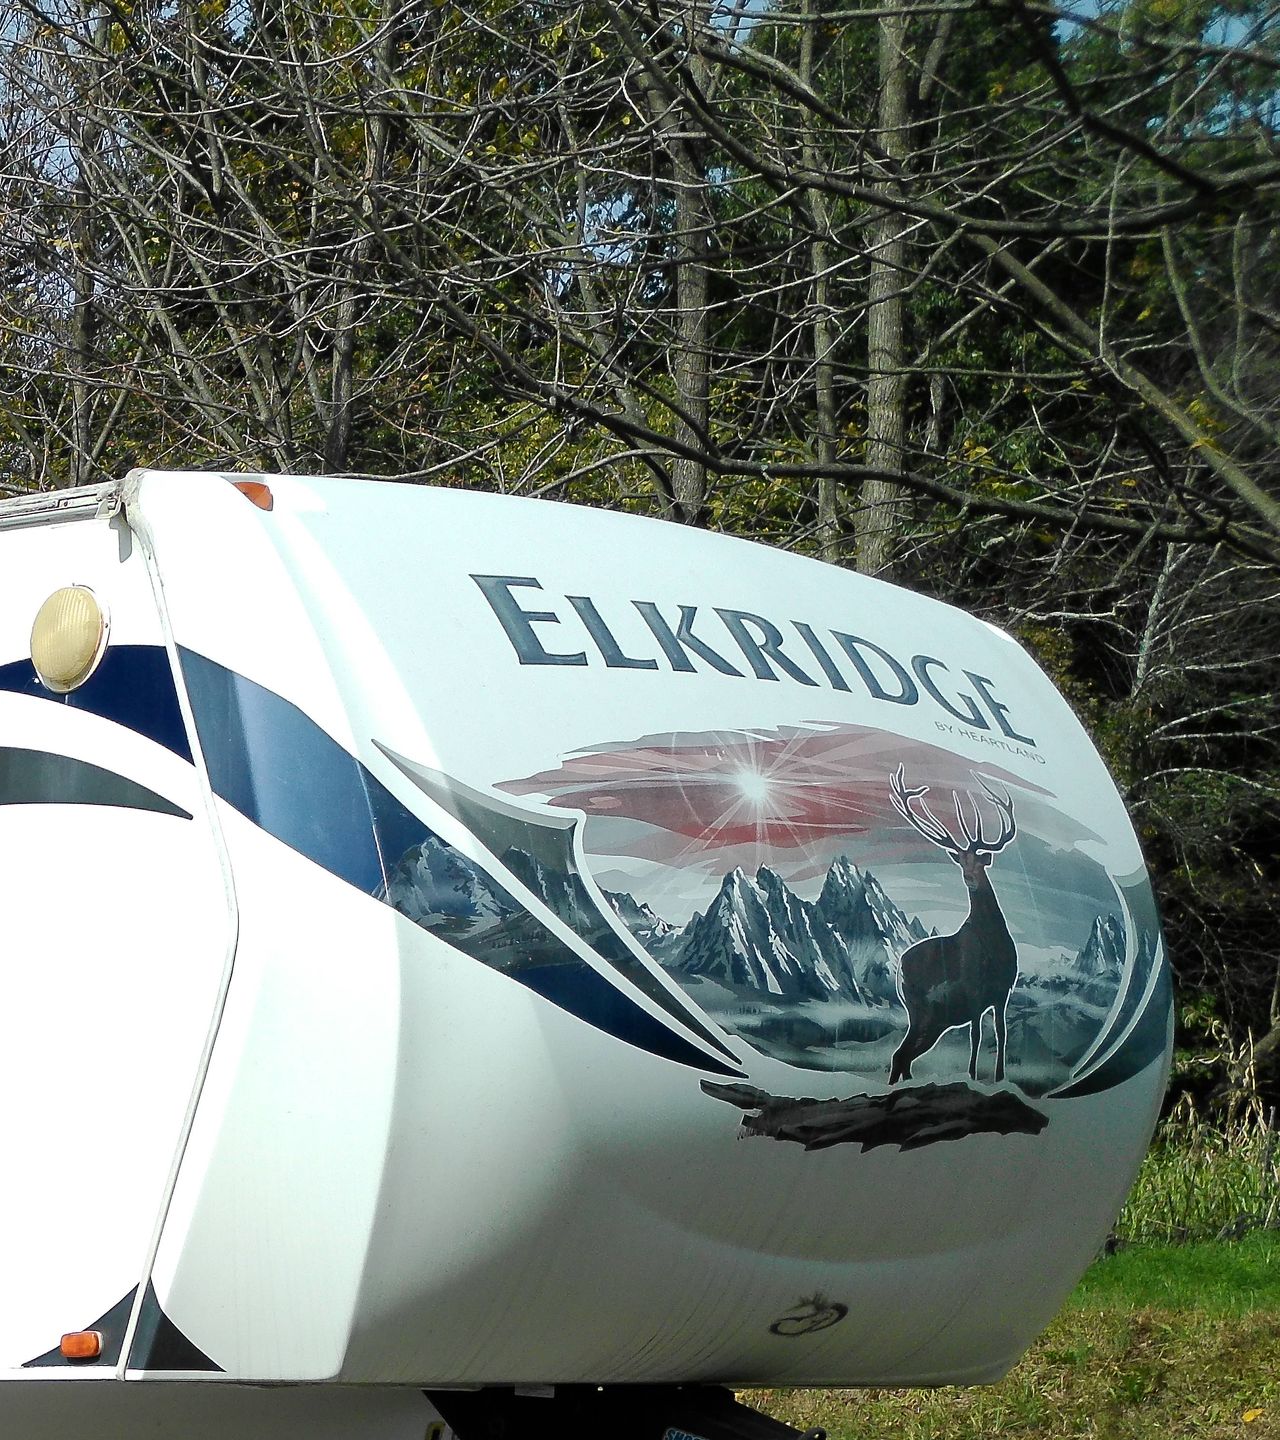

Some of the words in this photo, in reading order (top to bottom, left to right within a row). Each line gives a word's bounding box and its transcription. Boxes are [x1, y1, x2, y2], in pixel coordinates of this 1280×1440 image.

[468, 573, 1037, 747] ELKRIDGE
[934, 720, 953, 734] BY
[958, 728, 1046, 765] HEARTLAND
